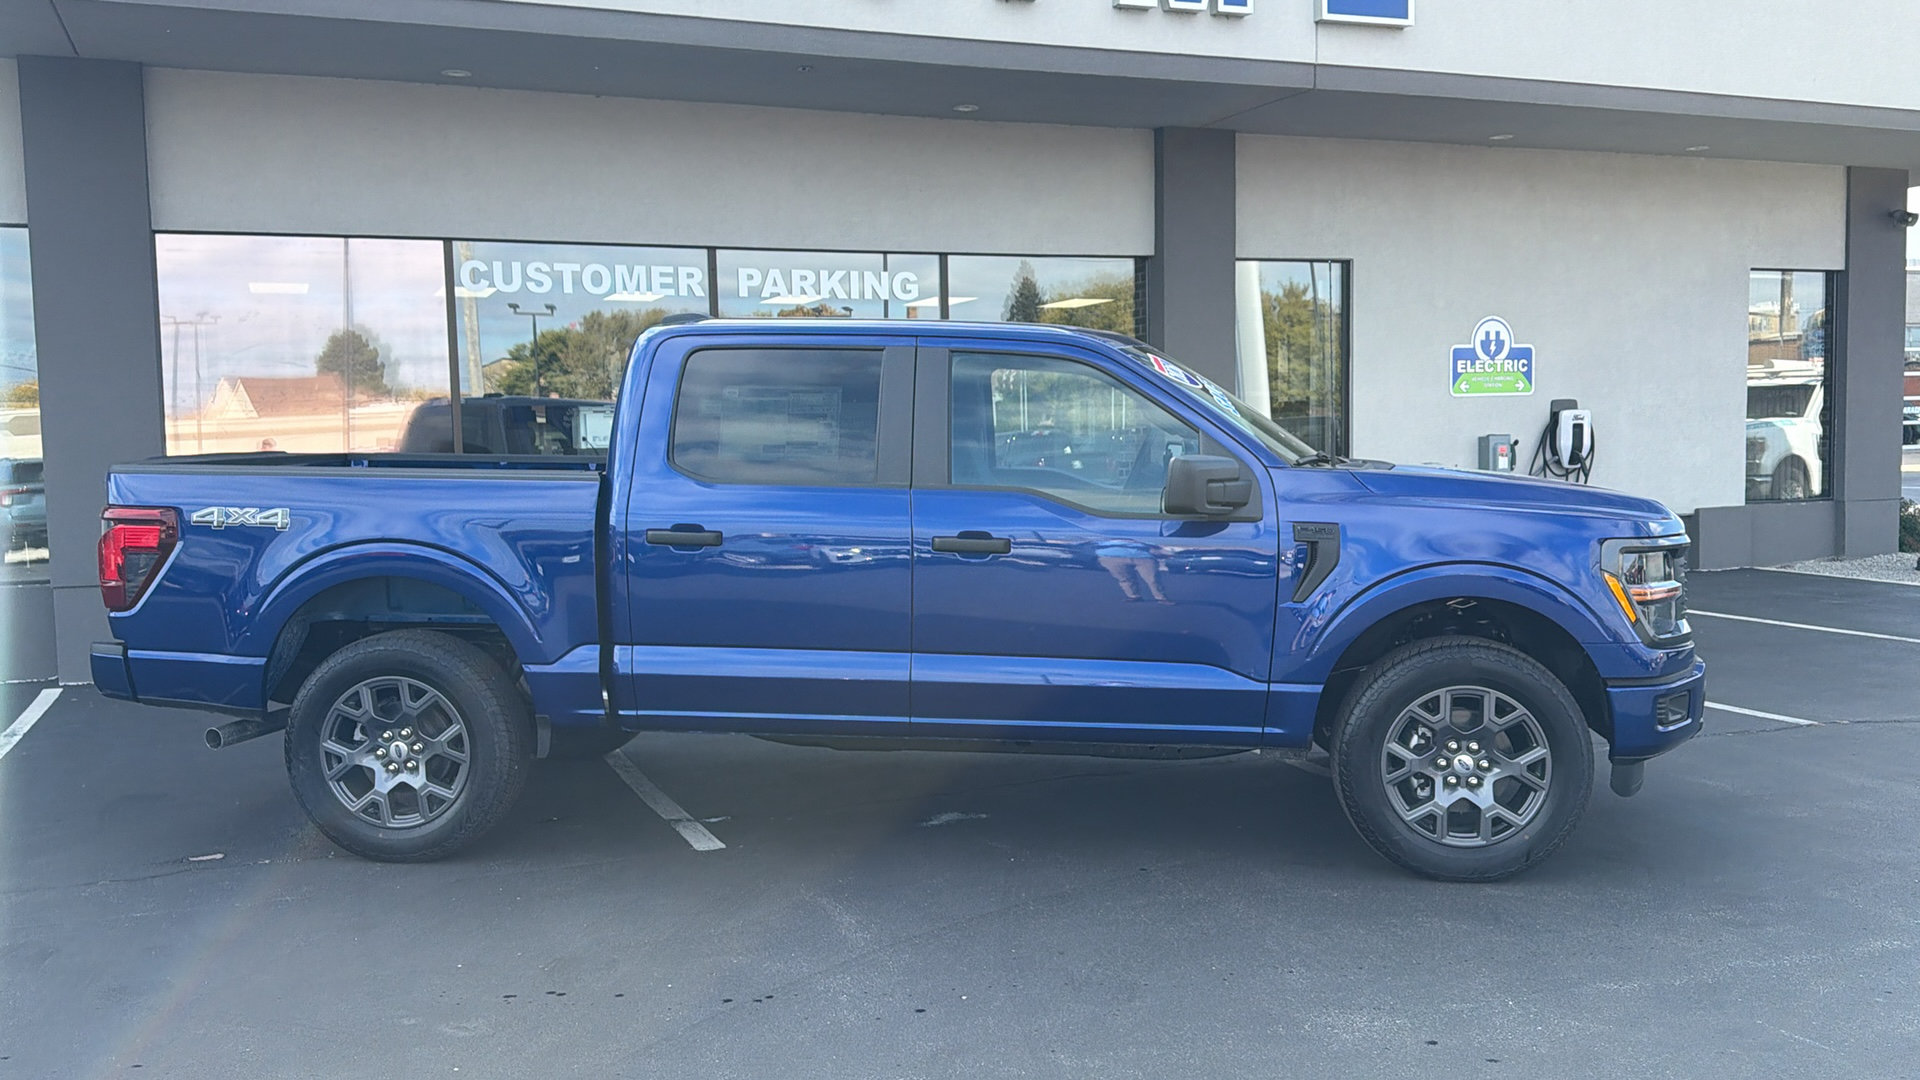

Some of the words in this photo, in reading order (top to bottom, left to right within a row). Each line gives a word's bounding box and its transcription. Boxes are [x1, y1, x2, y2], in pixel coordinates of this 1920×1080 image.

[459, 260, 708, 297] CUSTOMER
[737, 267, 920, 301] PARKING
[1457, 359, 1528, 373] ELECTRIC
